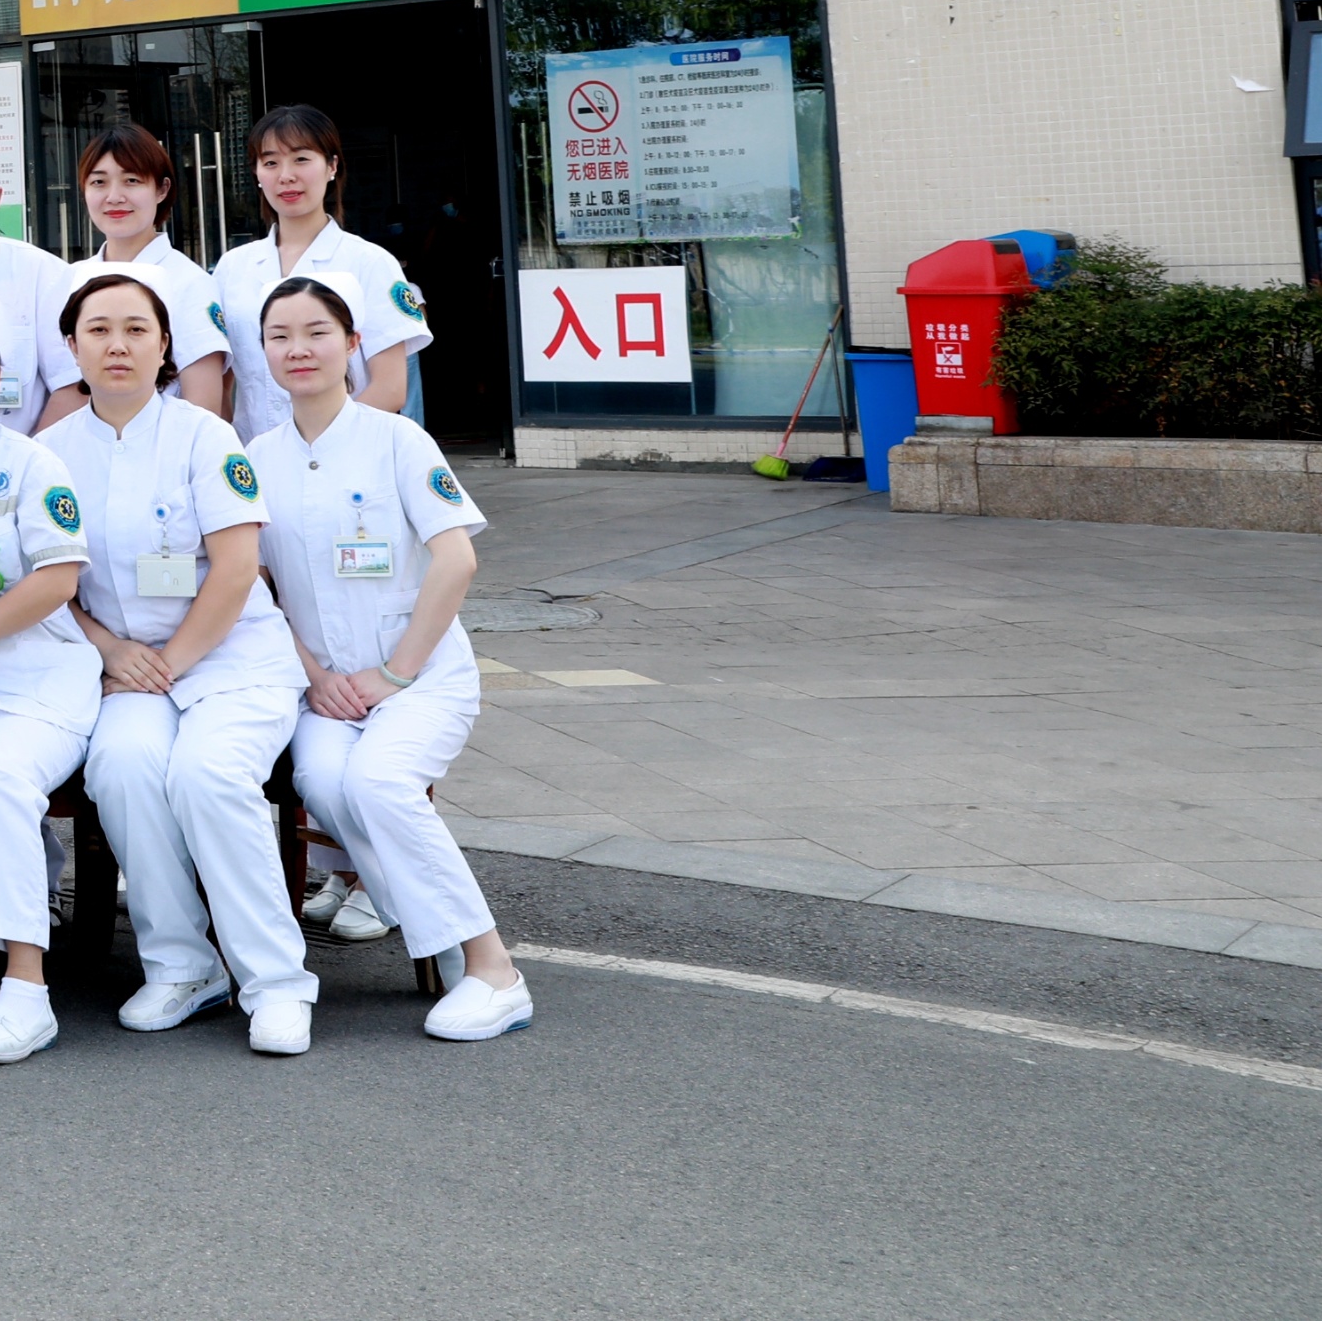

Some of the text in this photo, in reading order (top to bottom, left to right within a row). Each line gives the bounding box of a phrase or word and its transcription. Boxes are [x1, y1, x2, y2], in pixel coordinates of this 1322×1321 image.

[682, 52, 729, 64] 医院服务时间
[565, 136, 628, 158] 您已进入
[567, 160, 629, 181] 无烟医院
[569, 189, 630, 207] 禁止吸烟
[570, 208, 630, 218] NO SMOKING
[542, 286, 666, 361] 入口
